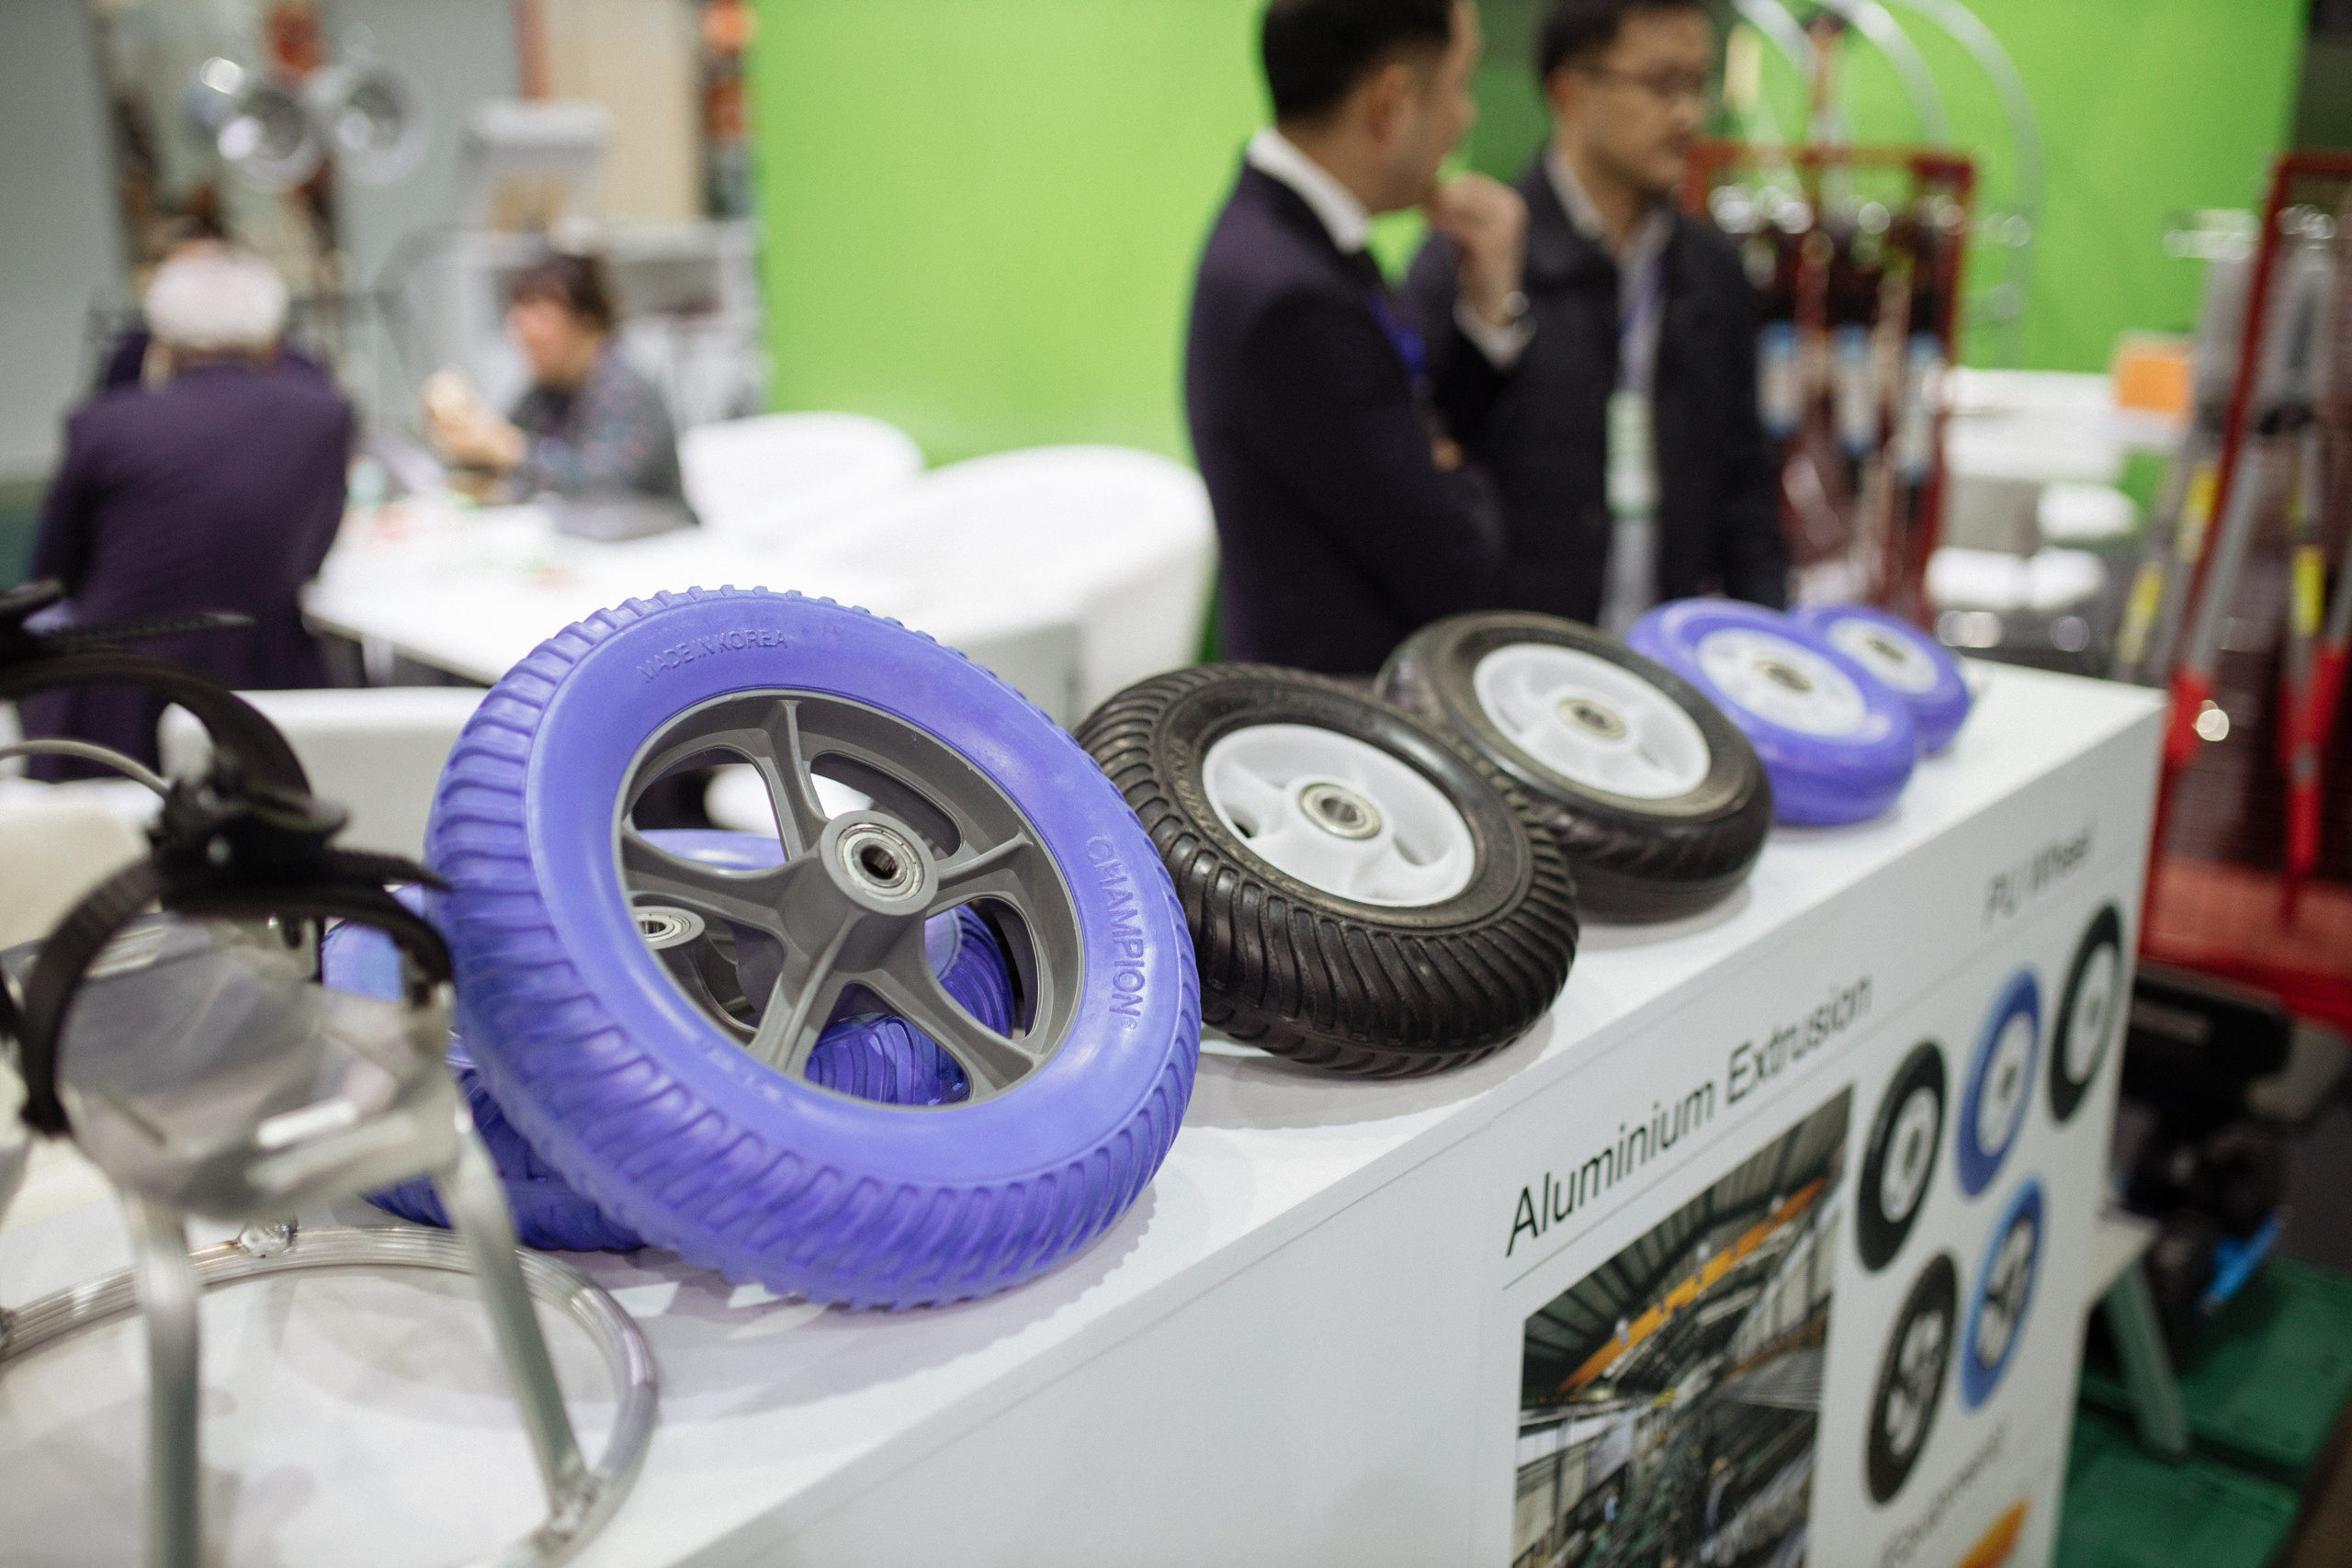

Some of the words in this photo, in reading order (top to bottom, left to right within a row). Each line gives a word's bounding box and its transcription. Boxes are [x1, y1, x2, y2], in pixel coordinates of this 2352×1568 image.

[637, 642, 695, 683] MADE
[713, 628, 788, 654] KOREA
[1505, 1080, 1716, 1258] Aluminium
[1725, 976, 1872, 1106] Extrusion
